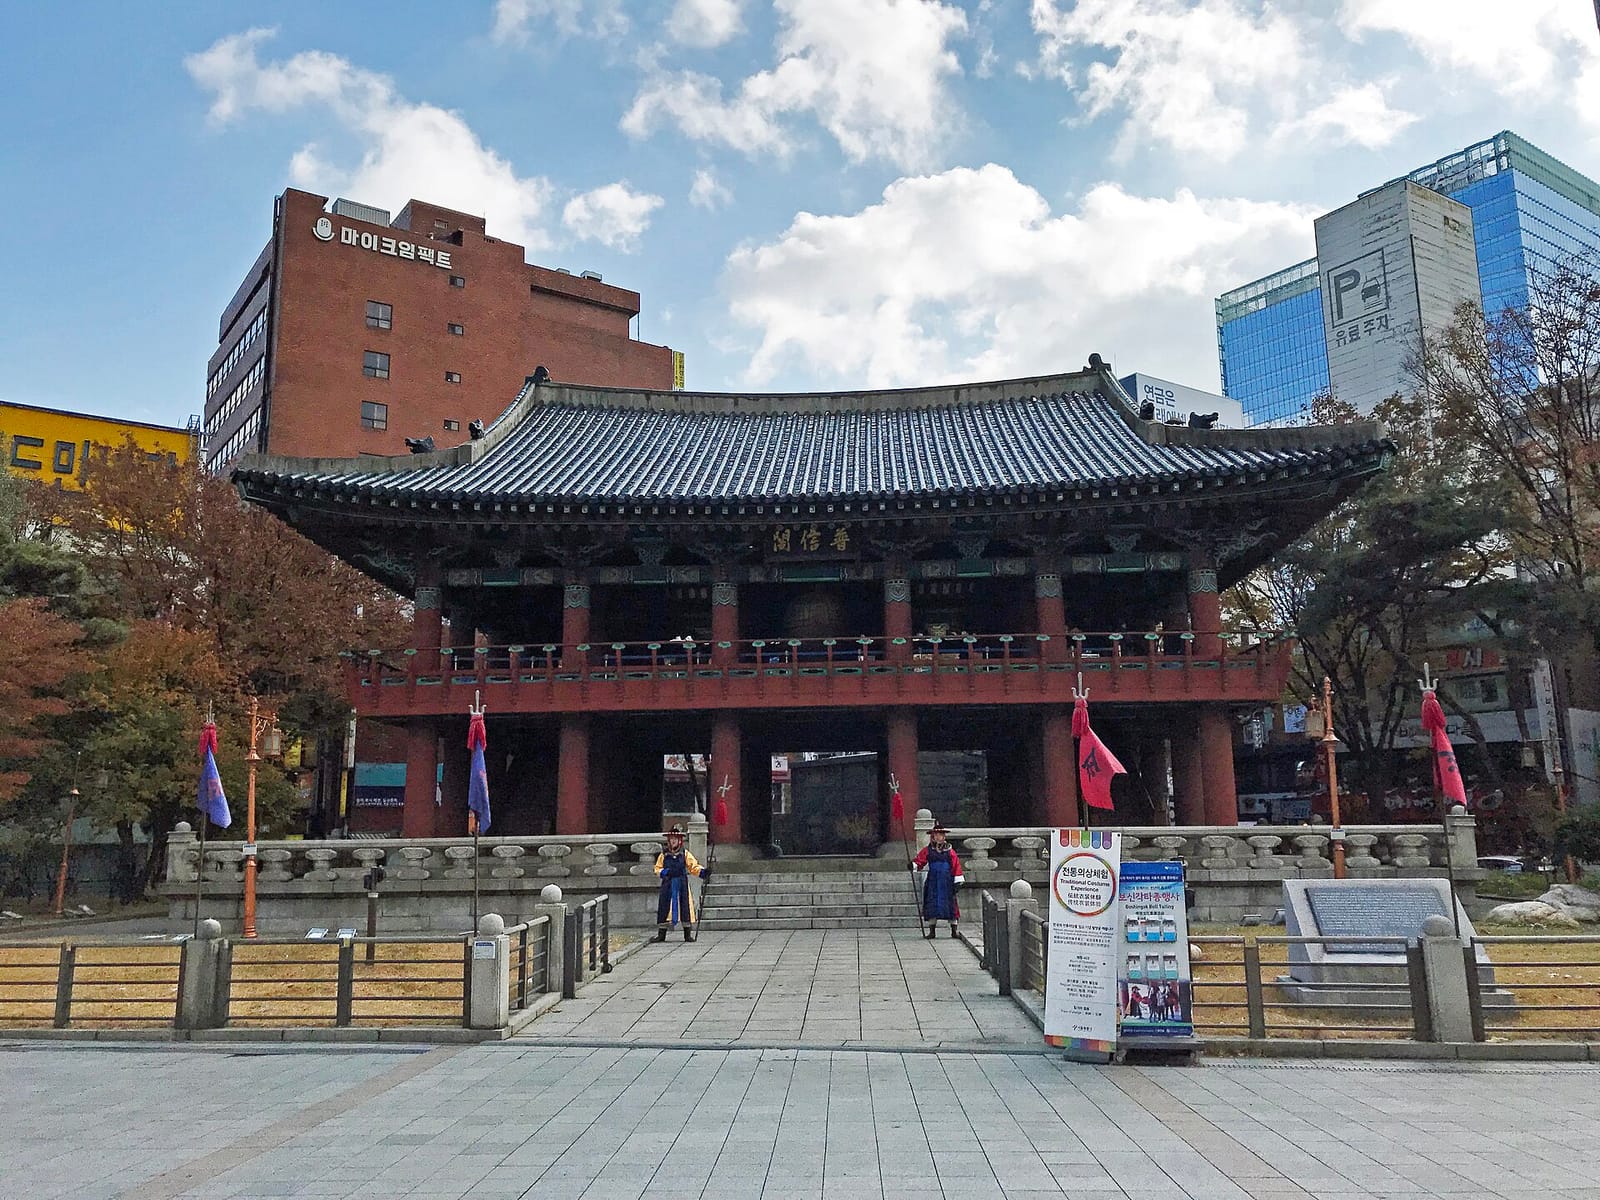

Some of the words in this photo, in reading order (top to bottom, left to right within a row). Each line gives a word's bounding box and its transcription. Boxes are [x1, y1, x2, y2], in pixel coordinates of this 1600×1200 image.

[340, 226, 453, 270] 마이크임팩트
[1333, 268, 1361, 321] P
[1335, 324, 1361, 348] 유료
[1143, 383, 1176, 408] 연금은
[1060, 878, 1087, 886] Traditional
[1062, 866, 1109, 880] 전통의상체험
[1118, 891, 1180, 903] 보신각타종행사
